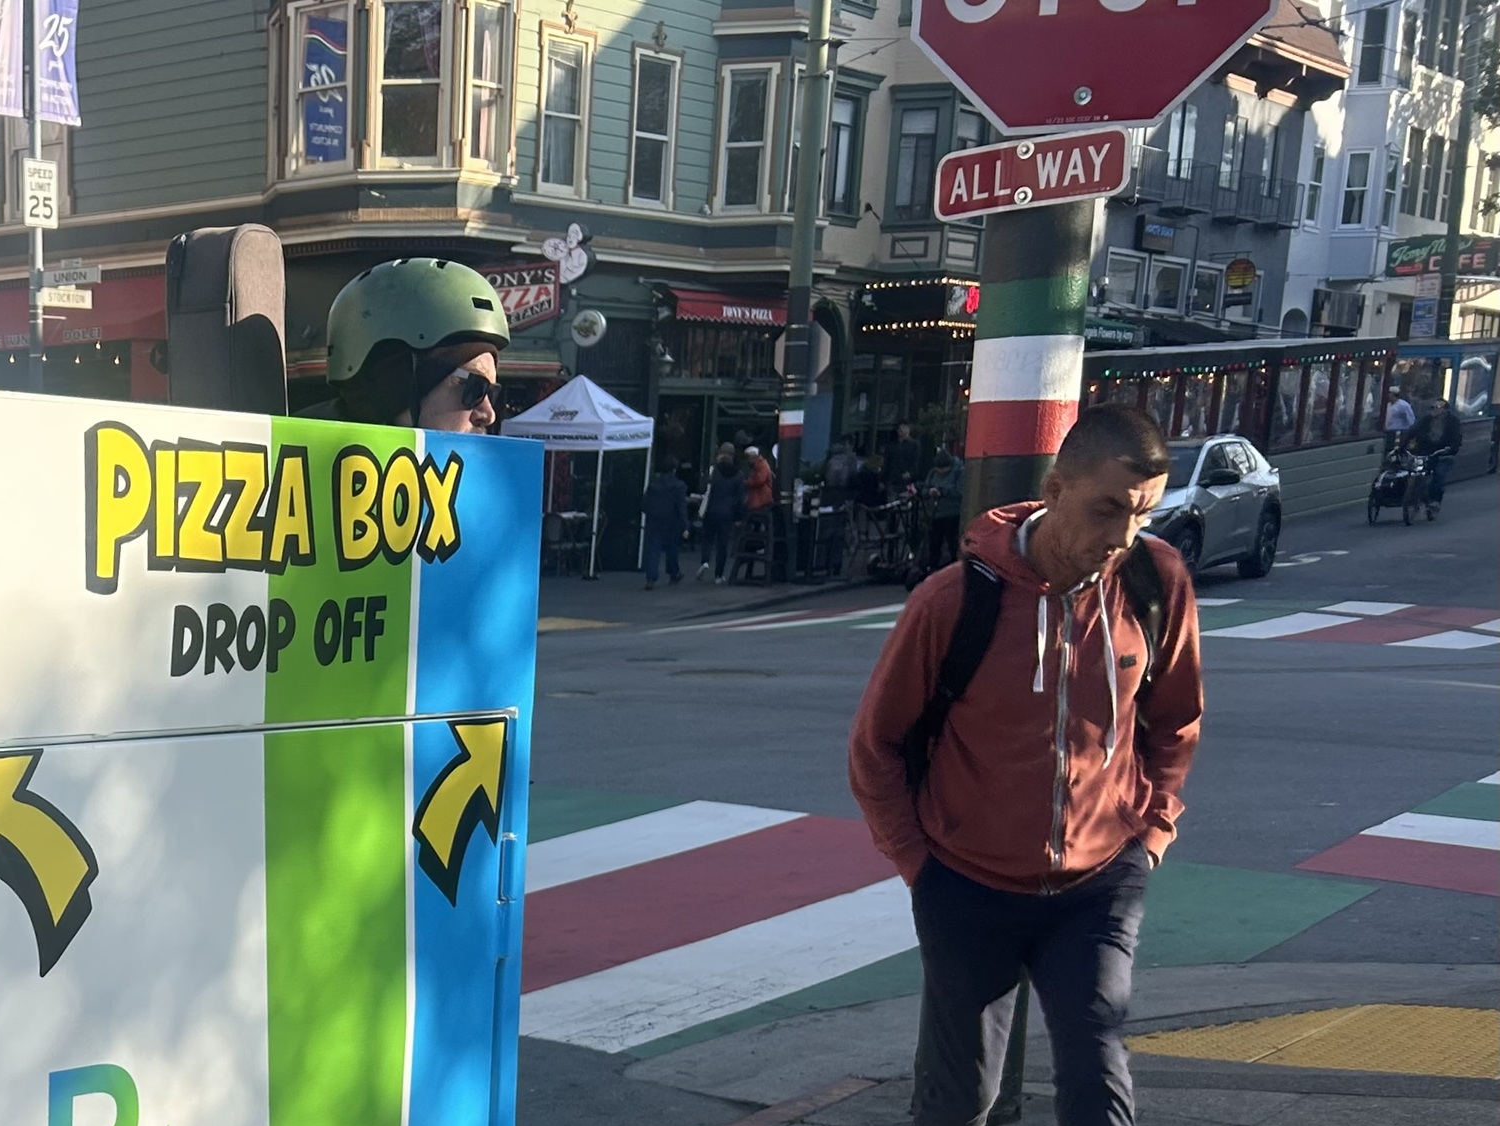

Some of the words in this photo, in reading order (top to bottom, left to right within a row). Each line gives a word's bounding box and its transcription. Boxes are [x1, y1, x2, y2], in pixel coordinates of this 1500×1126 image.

[38, 13, 73, 58] 25
[28, 167, 54, 180] SPEED
[949, 159, 1011, 205] ALL
[1036, 143, 1111, 190] WAY
[30, 181, 51, 192] LIMIT
[29, 195, 53, 219] 25
[1428, 253, 1486, 272] CFE
[53, 271, 88, 283] UNION
[484, 268, 556, 287] ONY'S
[48, 291, 86, 304] STOCKTON
[498, 286, 552, 314] ZZA
[509, 299, 551, 322] ETANA
[722, 305, 750, 318] TONY'S
[751, 308, 773, 320] PIZZA
[84, 420, 316, 595] PIZZA
[331, 444, 465, 572] BOX
[170, 598, 297, 678] DROP
[314, 596, 388, 666] OFF
